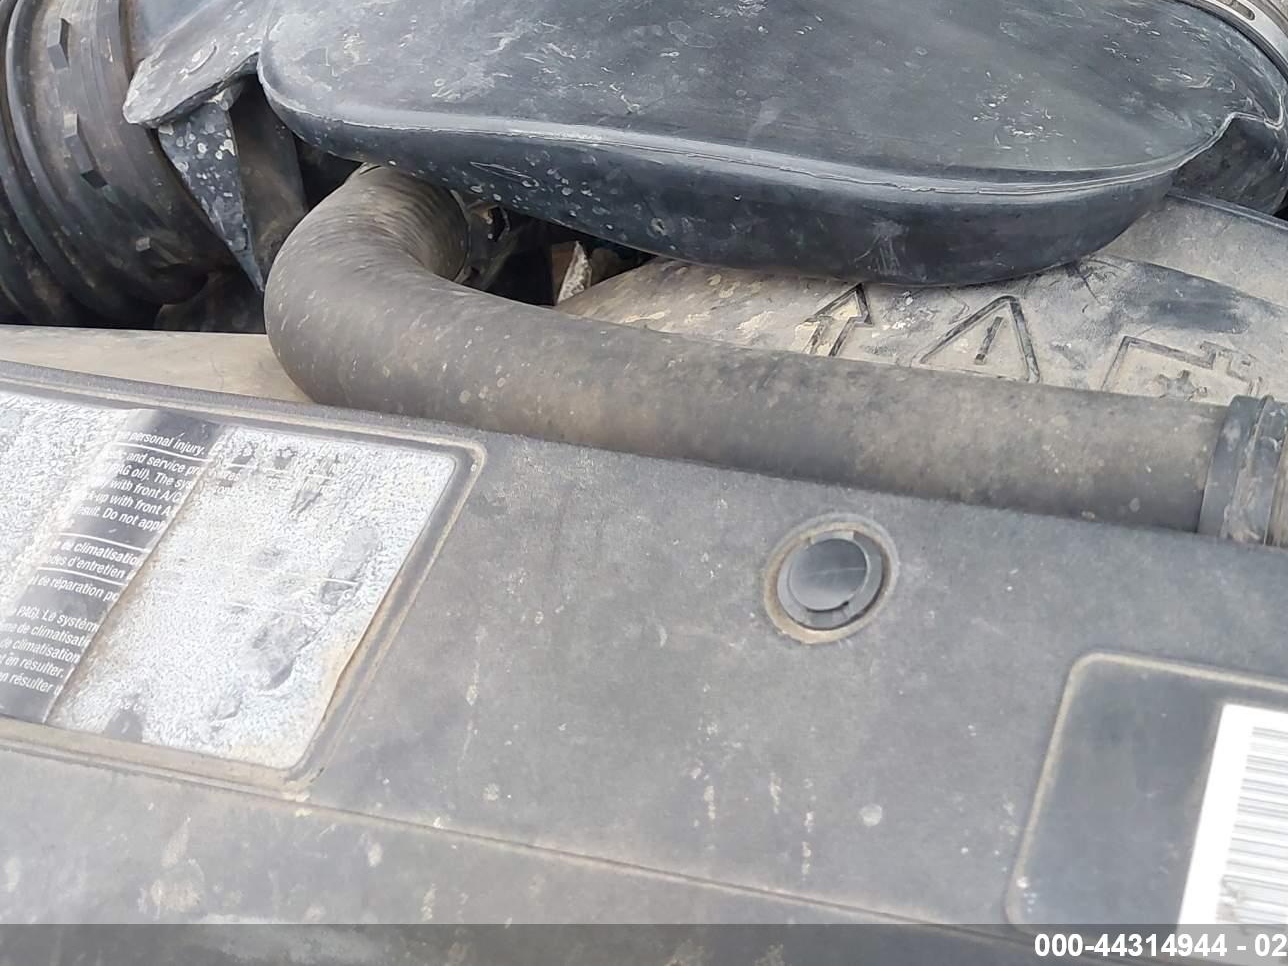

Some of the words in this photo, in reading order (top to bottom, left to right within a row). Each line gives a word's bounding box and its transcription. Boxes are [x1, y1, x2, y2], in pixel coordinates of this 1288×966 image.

[173, 439, 205, 455] injury.
[126, 452, 148, 464] and
[147, 456, 186, 472] service
[154, 472, 174, 486] The
[110, 480, 133, 492] with
[133, 483, 160, 499] front
[109, 495, 134, 508] with
[134, 499, 162, 515] front
[102, 507, 118, 520] Do
[119, 514, 139, 525] not
[67, 556, 126, 579] d'entretien
[41, 609, 56, 622] Le
[17, 622, 30, 634] de
[12, 639, 81, 664] climatisation
